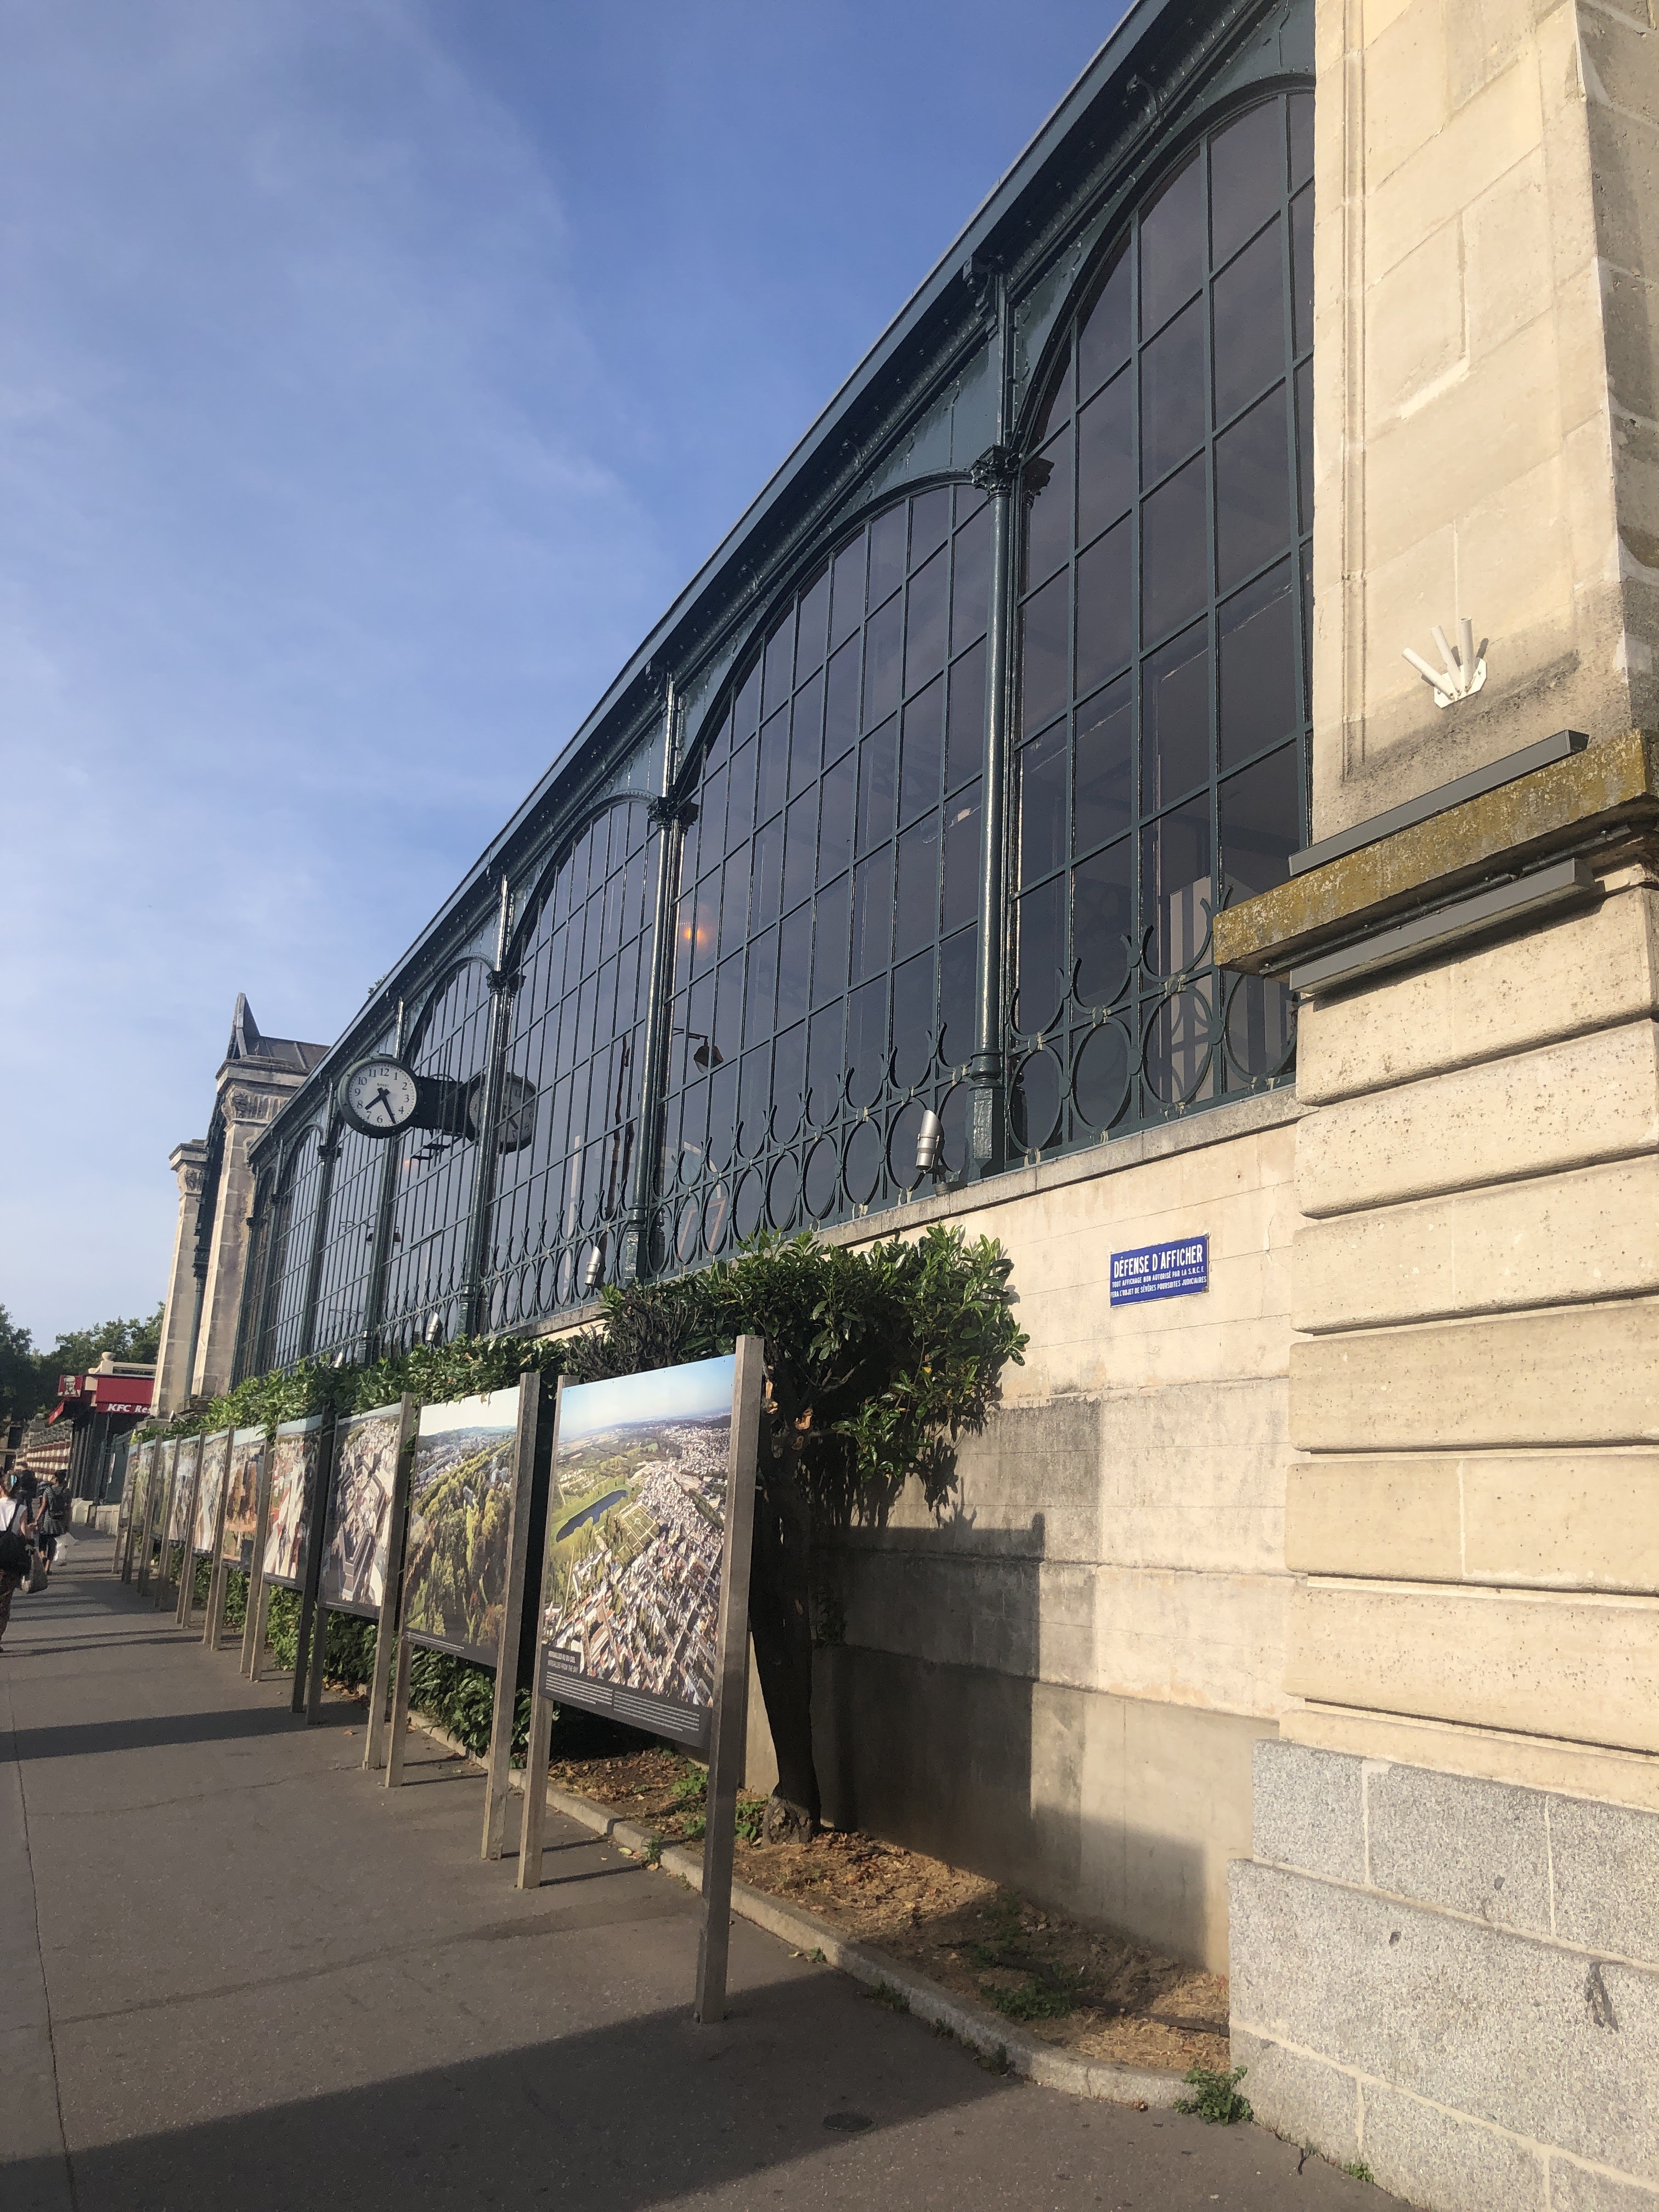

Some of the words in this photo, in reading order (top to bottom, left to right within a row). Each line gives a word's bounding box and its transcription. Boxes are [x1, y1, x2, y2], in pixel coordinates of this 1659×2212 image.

[369, 1069, 376, 1077] 11
[380, 1068, 390, 1077] 12
[394, 1072, 398, 1080] 1
[358, 1077, 368, 1086] 10
[402, 1082, 408, 1091] 2
[354, 1088, 361, 1096] 9
[404, 1094, 410, 1103] 3
[357, 1100, 363, 1109] 8
[398, 1106, 404, 1114] 4
[366, 1110, 372, 1120] 7
[376, 1115, 383, 1124] 6
[1114, 1254, 1149, 1278] DÉFENSE
[1152, 1244, 1203, 1272] D'AFFICHER
[1122, 1277, 1142, 1286] AFFICHAGE
[1152, 1271, 1171, 1281] AUTORISÉ
[1157, 1280, 1181, 1290] POURSUITES
[1181, 1276, 1206, 1285] JUDICIAIRES
[107, 1403, 132, 1412] KFC
